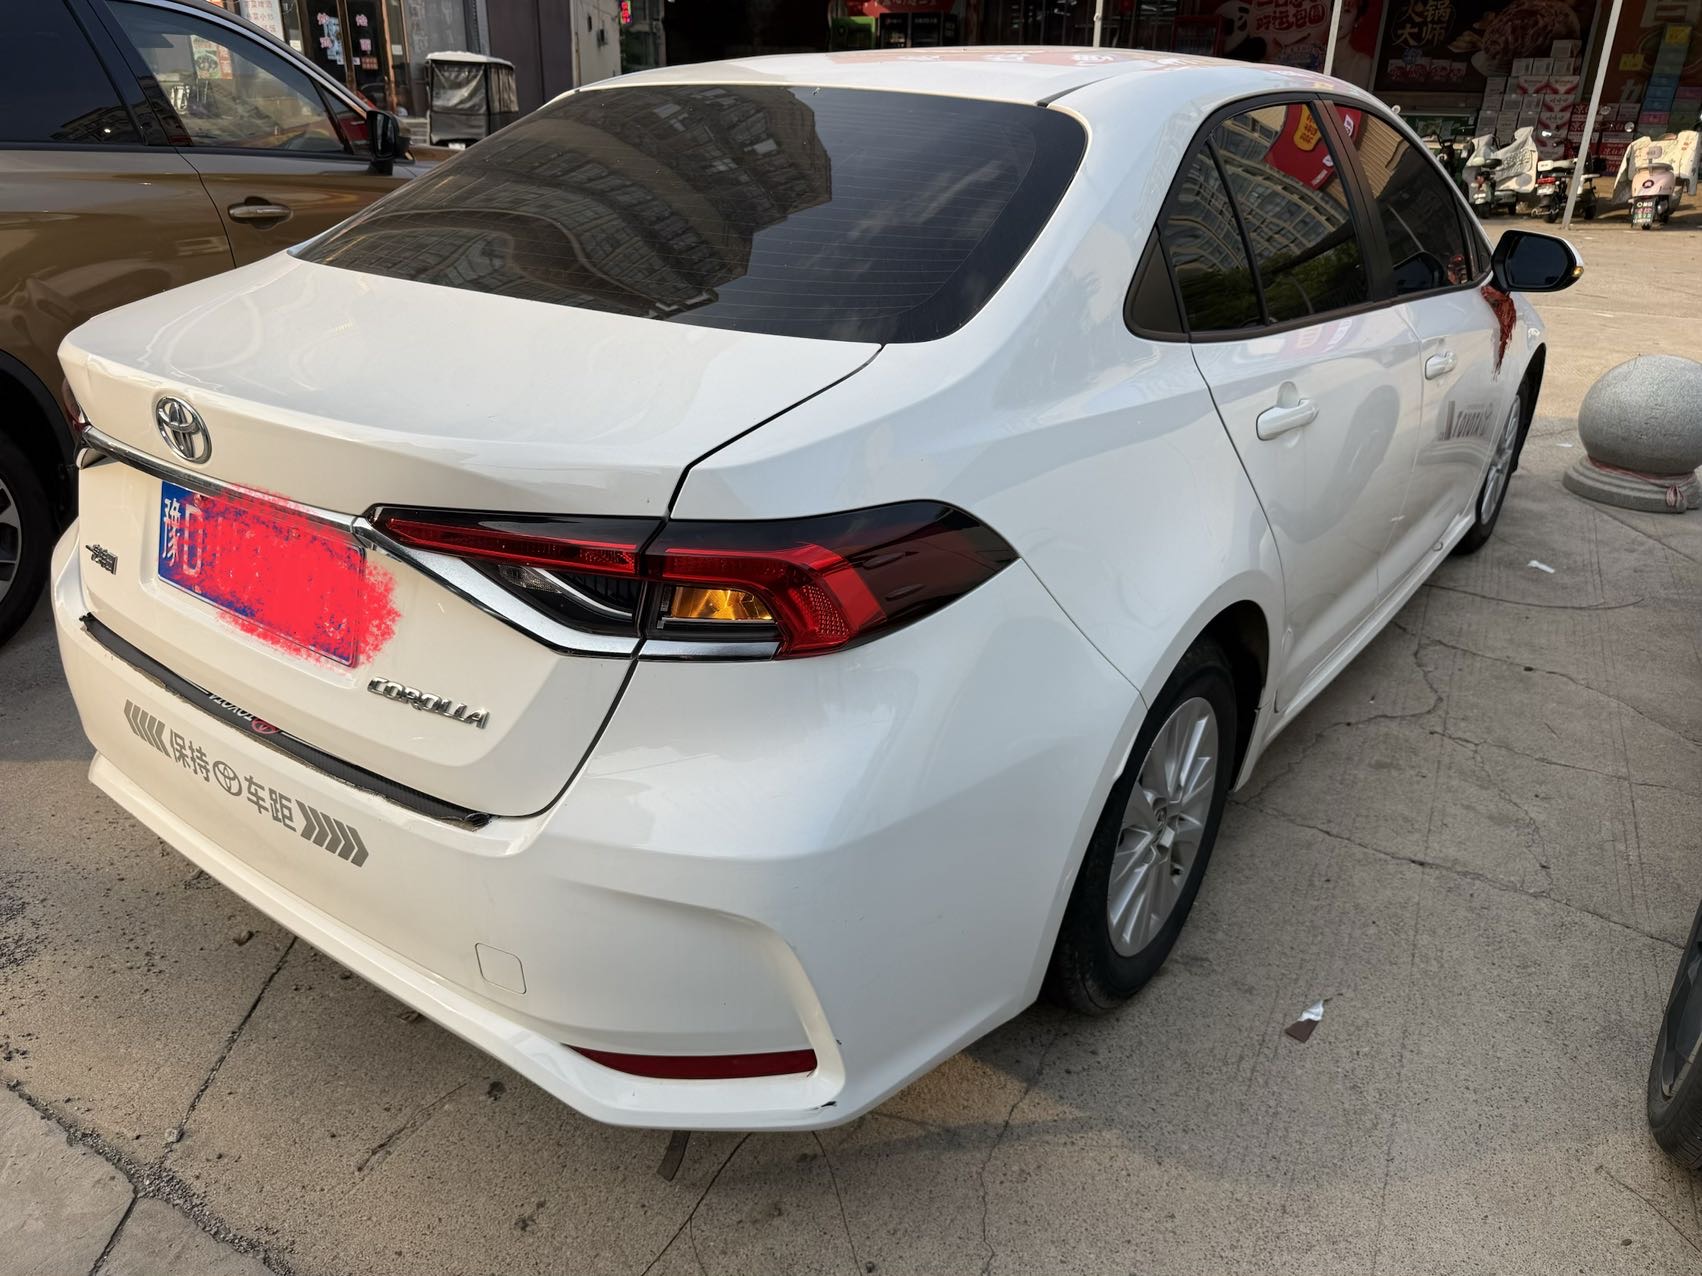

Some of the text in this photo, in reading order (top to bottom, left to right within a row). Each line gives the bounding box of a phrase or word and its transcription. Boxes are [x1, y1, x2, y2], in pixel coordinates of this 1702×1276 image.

[367, 676, 490, 730] COROLLA
[169, 728, 298, 833] 保持 车距
